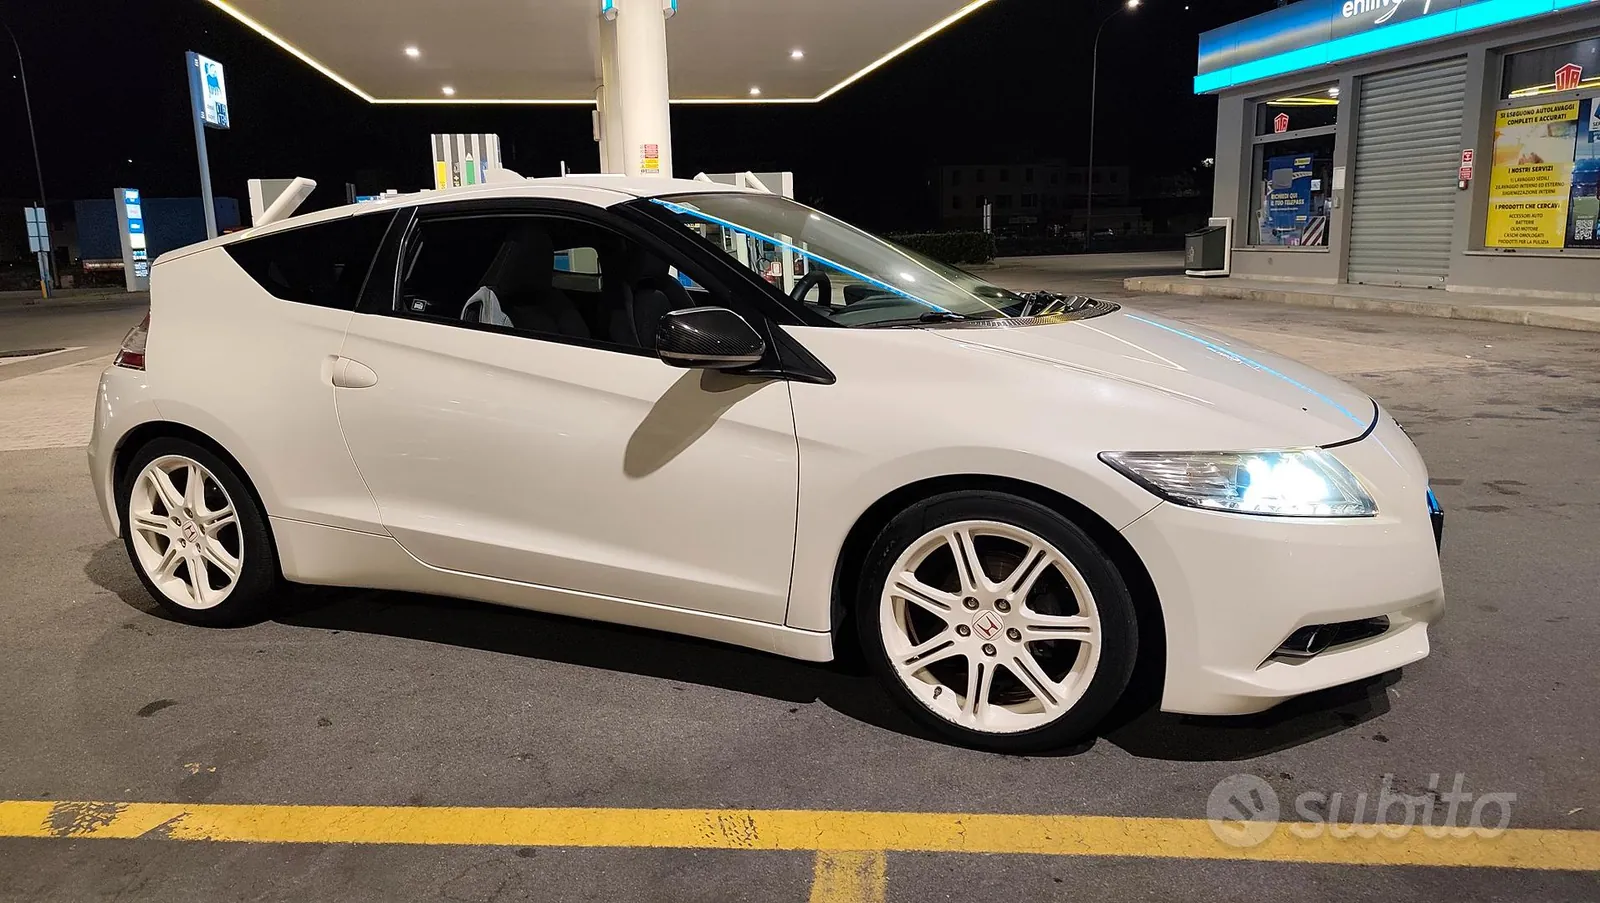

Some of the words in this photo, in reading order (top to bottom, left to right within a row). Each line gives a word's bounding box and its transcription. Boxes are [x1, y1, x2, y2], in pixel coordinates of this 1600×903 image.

[1506, 109, 1535, 118] ESEGUONO
[1536, 103, 1575, 114] AUTOLAVAGGI
[1507, 117, 1533, 126] COMPLETI
[1539, 113, 1567, 122] ACCURATI
[1511, 166, 1531, 174] NOSTRI
[1531, 165, 1554, 173] SERVIZI
